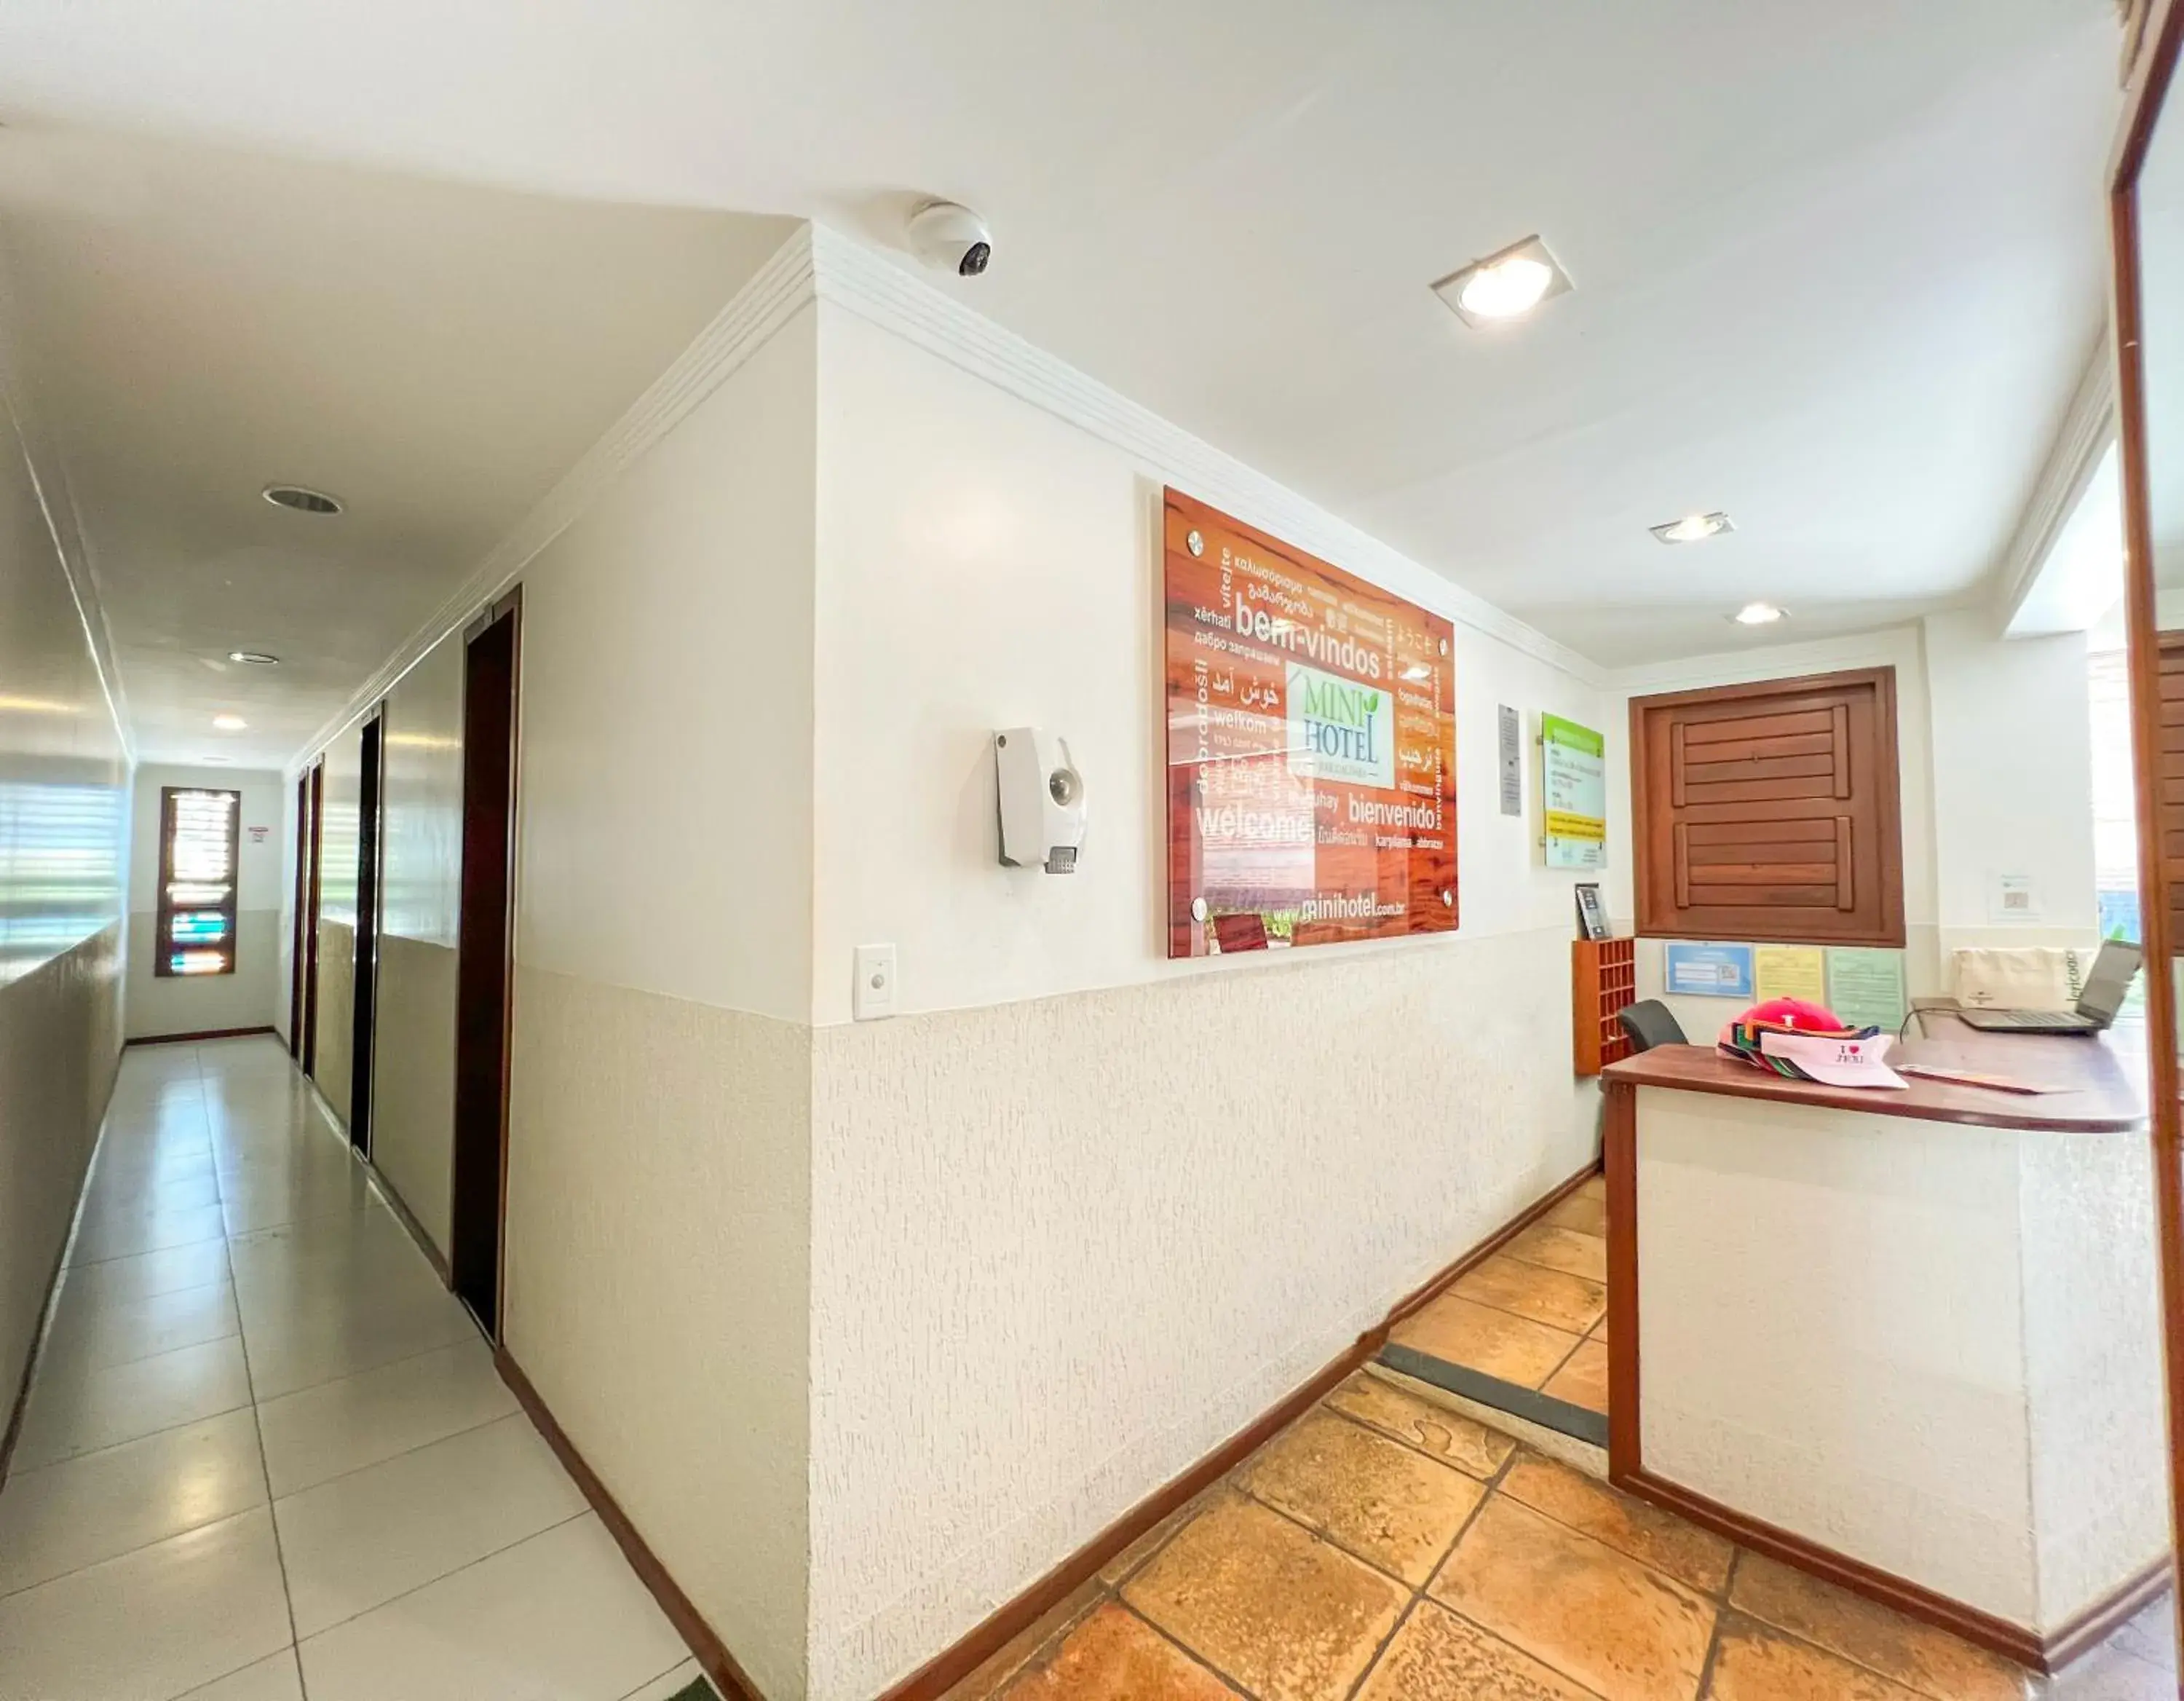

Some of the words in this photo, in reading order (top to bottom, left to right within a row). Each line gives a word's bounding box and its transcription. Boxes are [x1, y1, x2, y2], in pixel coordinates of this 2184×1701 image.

[1236, 591, 1380, 679] bem-vindos
[1304, 674, 1364, 727] MINI
[1304, 714, 1378, 763] HOTEL
[1349, 792, 1435, 830] bienvenido
